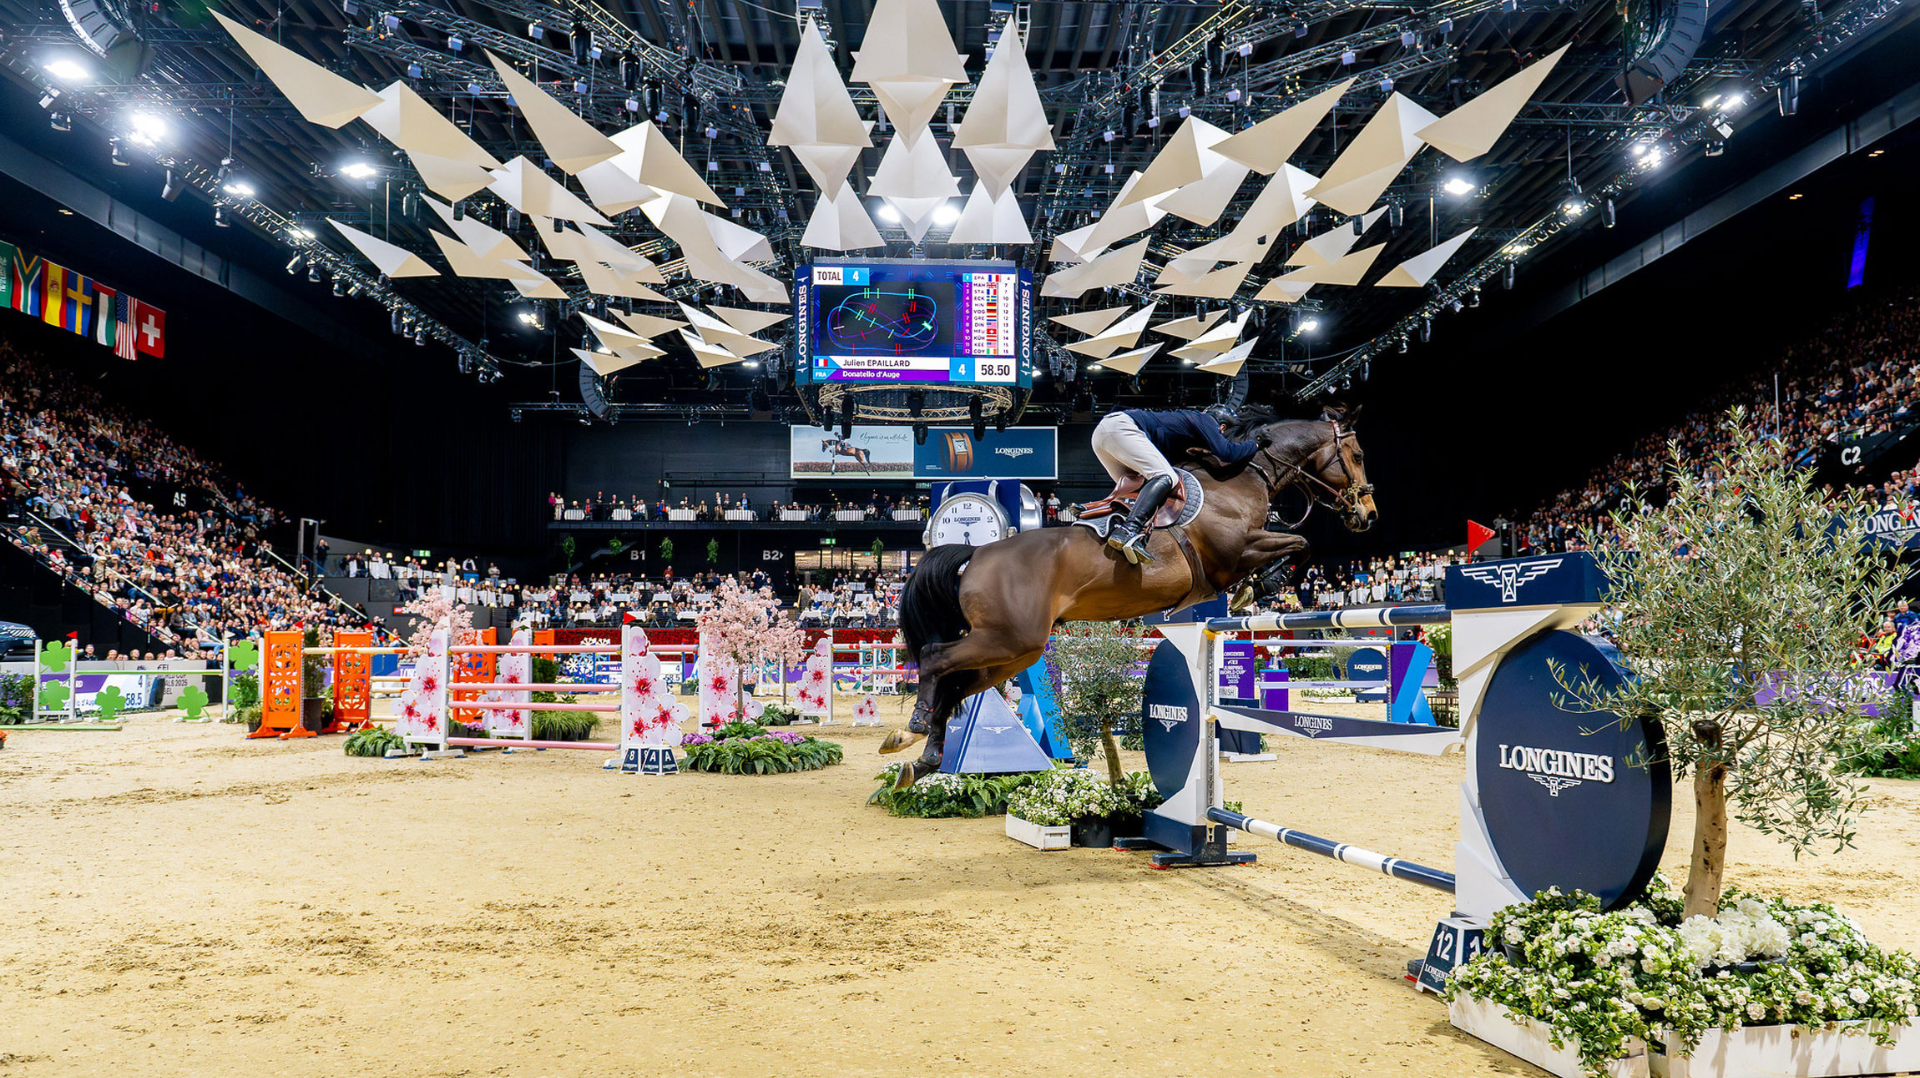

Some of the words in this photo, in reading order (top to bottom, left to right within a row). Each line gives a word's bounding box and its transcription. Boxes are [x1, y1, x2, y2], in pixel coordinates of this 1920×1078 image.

[817, 271, 841, 280] TOTAL
[852, 271, 860, 282] 4
[798, 285, 807, 366] LONGINES
[1022, 289, 1030, 368] LONGINES
[843, 359, 865, 367] Julien
[876, 371, 900, 379] d'Auge
[958, 364, 966, 376] 4
[981, 364, 1010, 376] 58.50
[1841, 446, 1861, 466] C2
[173, 491, 187, 507] A5
[942, 517, 951, 525] 10
[938, 531, 945, 539] 9
[990, 530, 997, 538] 3
[630, 550, 646, 561] B1
[762, 550, 779, 561] B2
[138, 675, 143, 688] 4
[126, 692, 142, 706] 58.5
[1149, 703, 1188, 722] LONGINES
[1294, 715, 1332, 731] LONGINES
[630, 750, 635, 761] 8
[650, 751, 657, 762] A
[665, 751, 671, 762] A
[1499, 744, 1615, 783] LONGINES
[1436, 930, 1453, 961] 12
